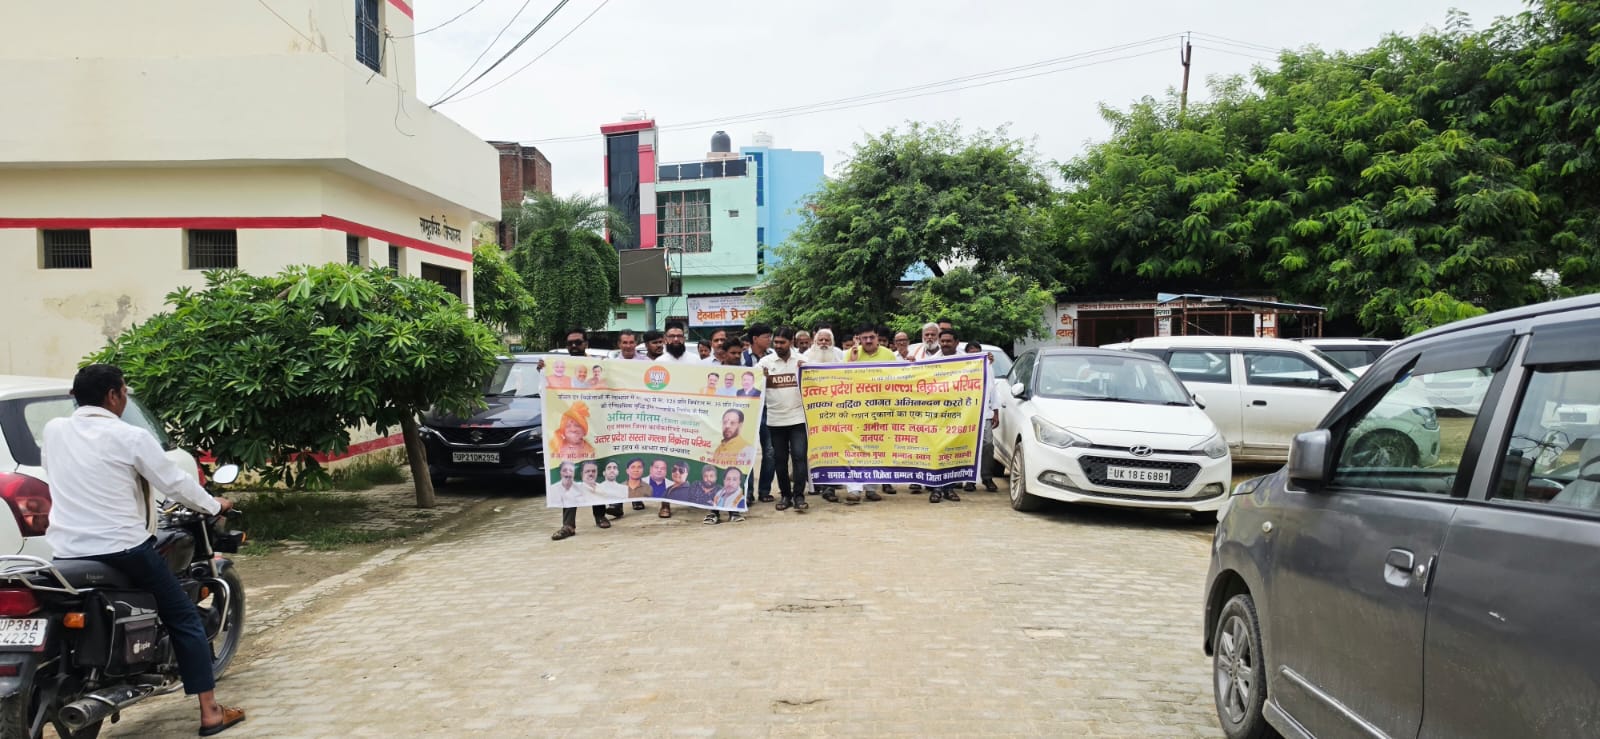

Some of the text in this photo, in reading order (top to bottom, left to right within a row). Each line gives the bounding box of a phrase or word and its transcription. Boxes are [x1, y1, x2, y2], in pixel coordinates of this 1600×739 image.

[803, 375, 982, 398] उत्तर प्रदेश सस्ता गल्ला विक्रेता परिषद
[807, 401, 832, 410] आपका
[864, 399, 890, 408] स्वागत
[894, 397, 940, 407] अभिनन्दन
[944, 398, 963, 407] करते
[608, 411, 632, 422] अमित
[820, 411, 836, 419] प्रदेश
[838, 410, 848, 418] की
[910, 411, 922, 419] एक
[822, 424, 852, 432] कार्यालय
[864, 422, 888, 432] अमीना
[892, 424, 906, 432] बाद
[594, 434, 610, 444] उत्तर
[612, 432, 627, 444] प्रदेश
[628, 433, 646, 442] सस्ता
[648, 434, 667, 442] गल्ला
[668, 432, 690, 446] विक्रेता
[860, 434, 884, 442] जनपद
[873, 469, 892, 479] विक्रेता
[916, 471, 924, 480] की
[926, 472, 942, 482] जिला
[1114, 470, 1124, 478] UK
[1128, 470, 1138, 478] 18
[0, 620, 38, 631] UP38A
